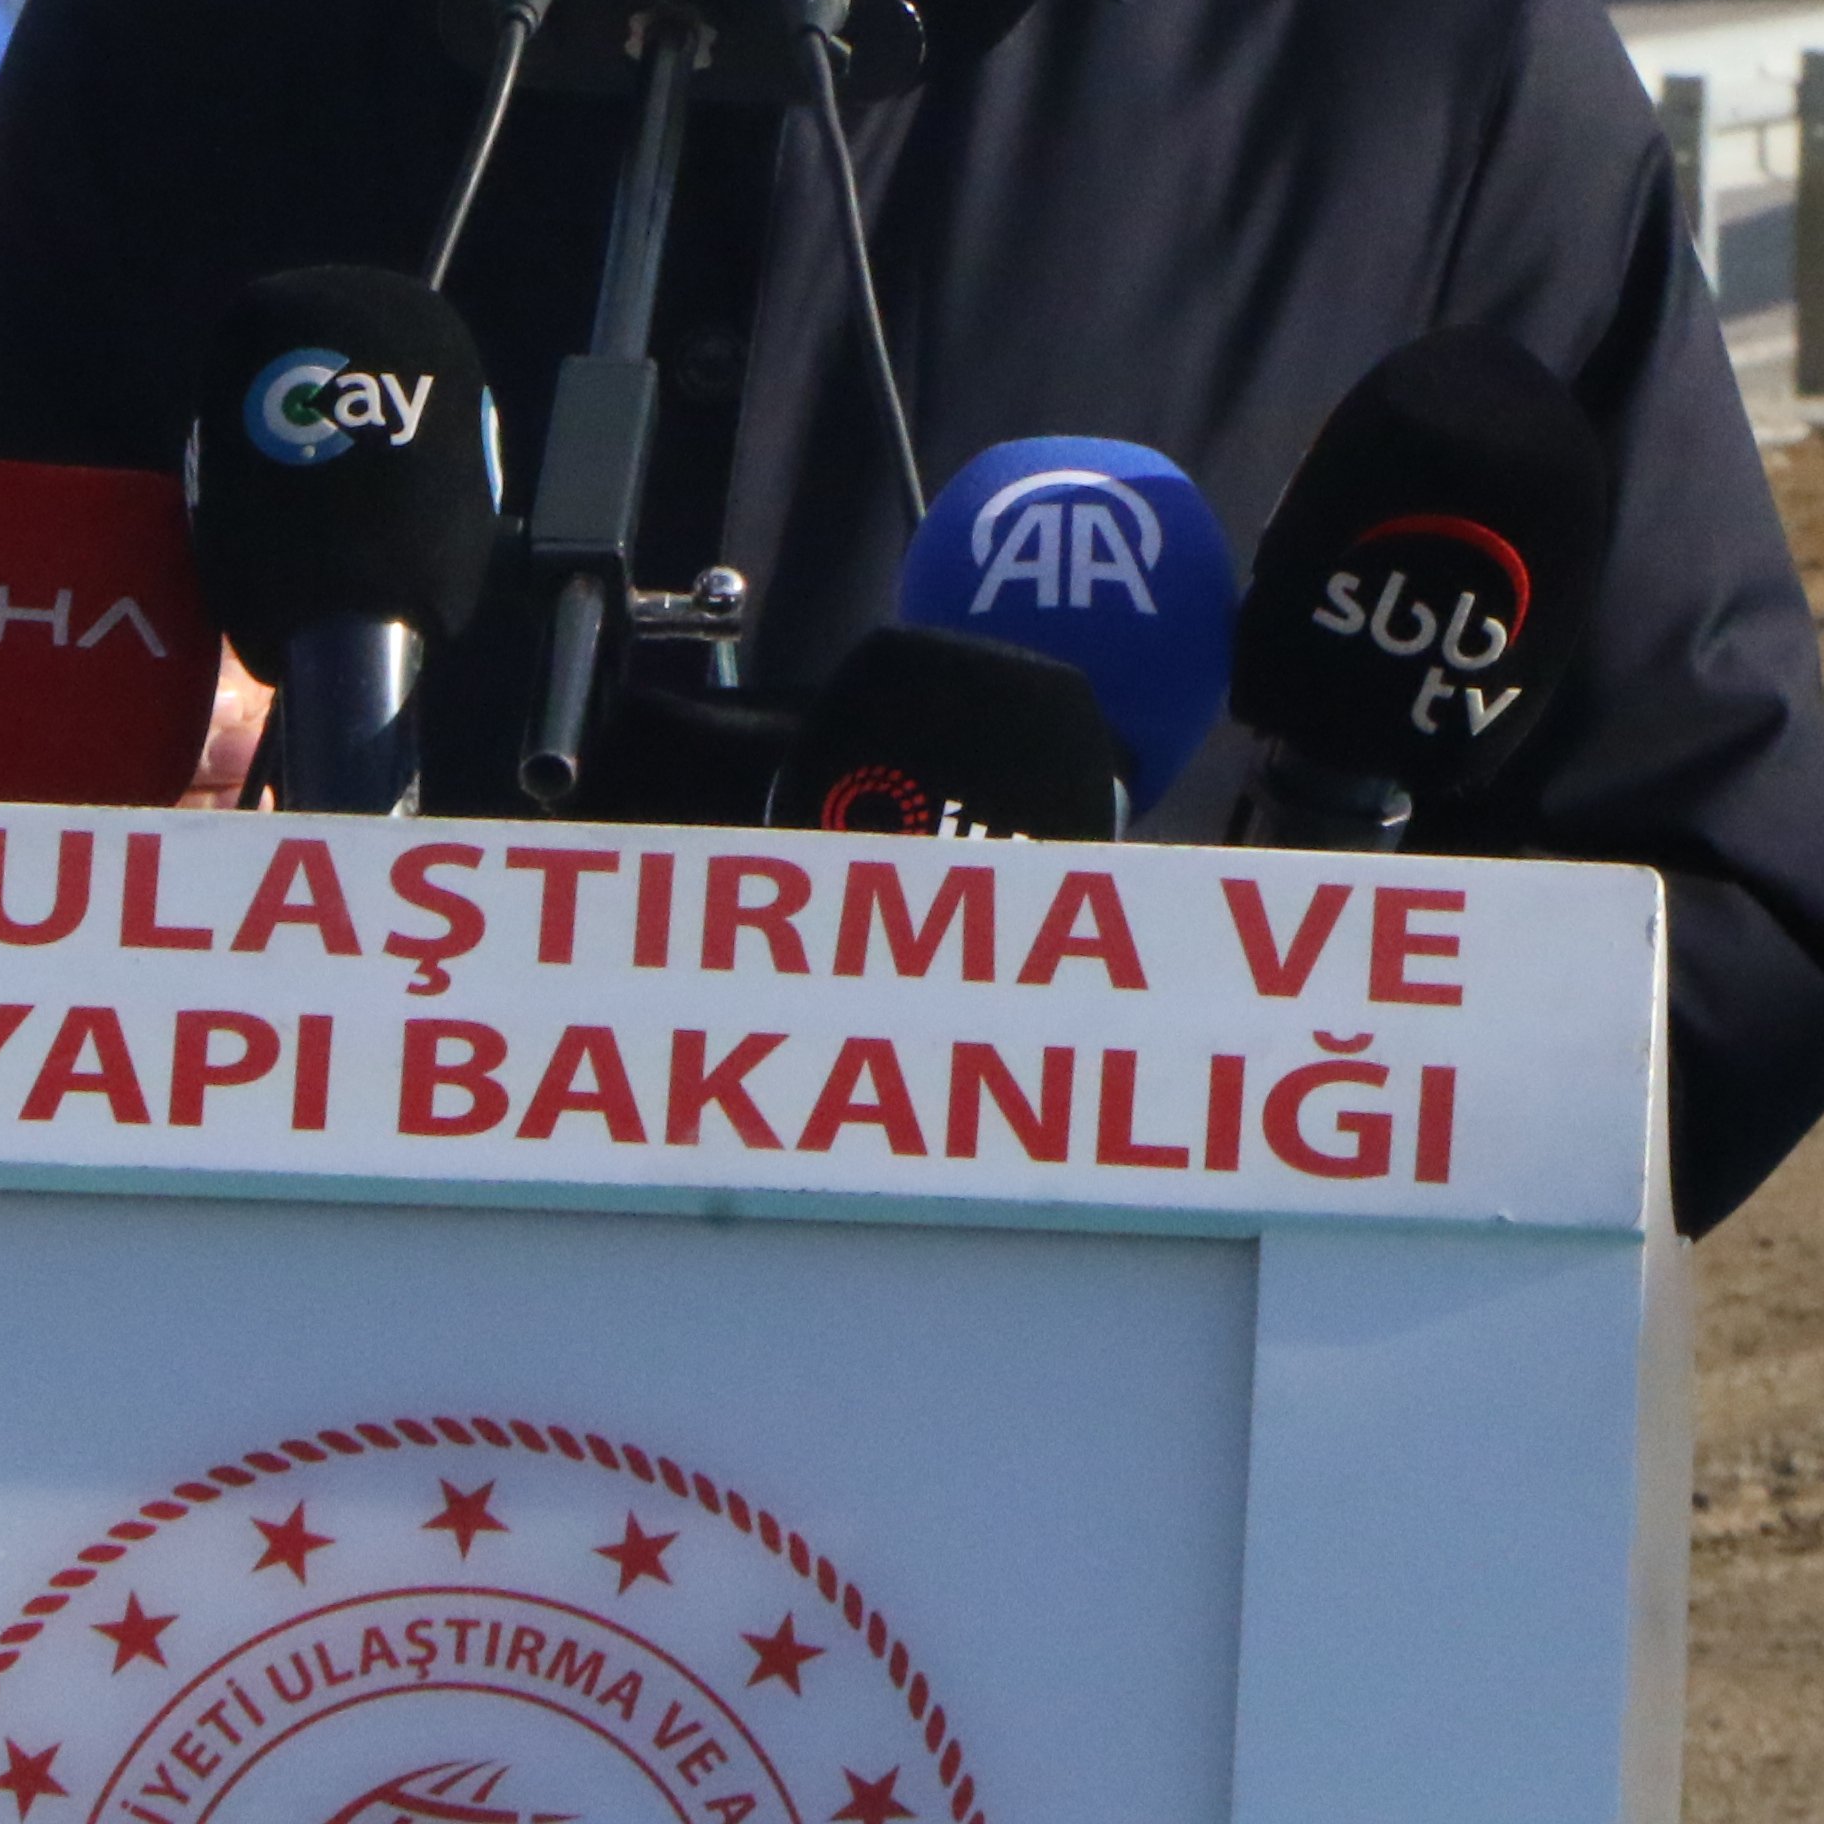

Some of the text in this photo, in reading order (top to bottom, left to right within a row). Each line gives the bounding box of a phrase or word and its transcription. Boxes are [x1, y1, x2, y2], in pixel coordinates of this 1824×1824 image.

[969, 502, 1160, 616] AA
[1311, 570, 1509, 672] sbb
[1411, 665, 1524, 737] tv
[1221, 878, 1467, 1007] VE
[398, 1018, 1457, 1185] BAKANLIĞI
[266, 1617, 643, 1721] ULAŞTIRMA
[653, 1700, 730, 1788] VE
